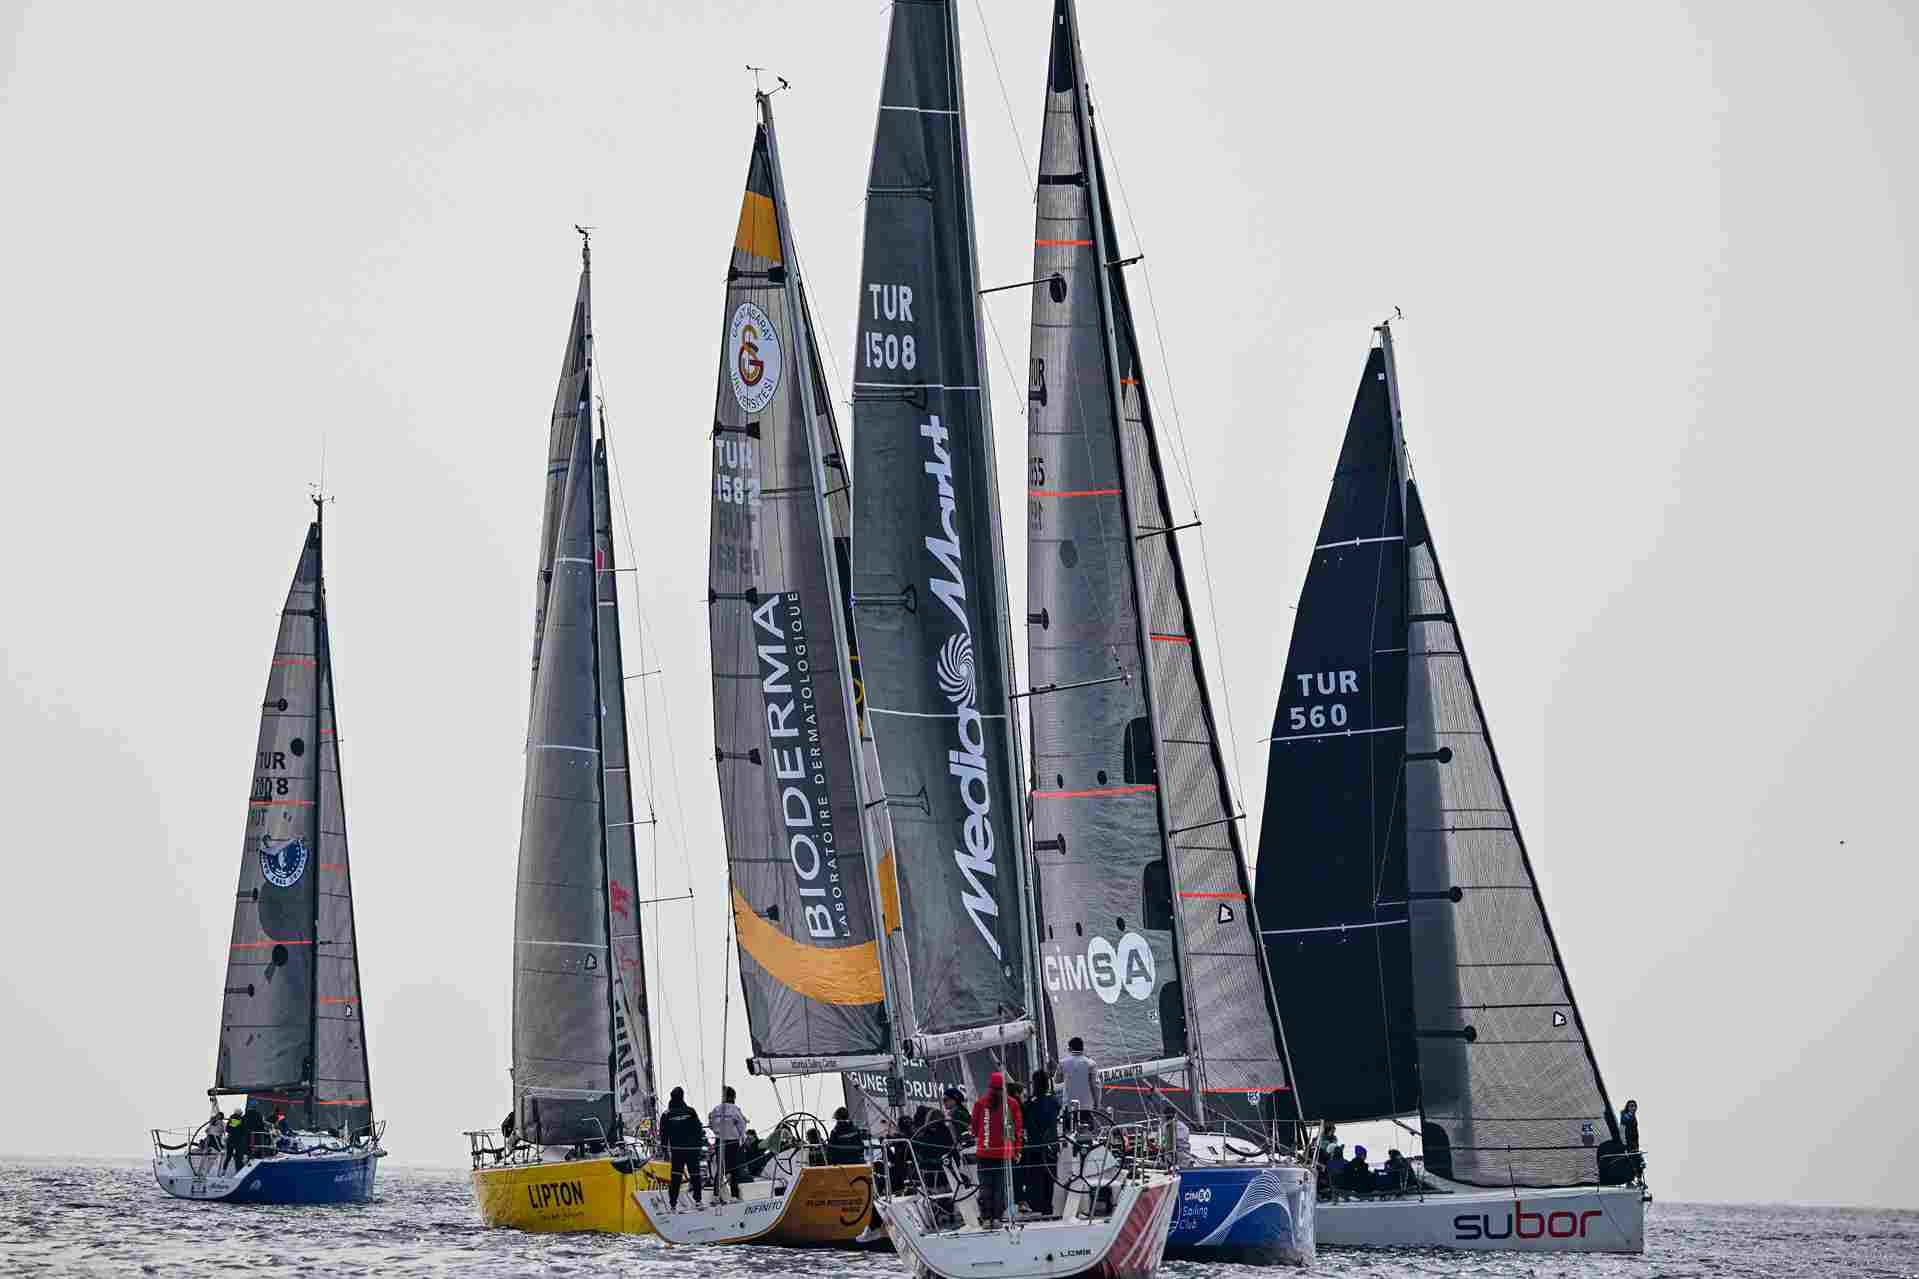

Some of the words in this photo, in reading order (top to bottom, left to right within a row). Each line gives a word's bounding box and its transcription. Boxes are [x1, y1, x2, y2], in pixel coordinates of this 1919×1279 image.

[868, 284, 913, 322] TUR
[864, 332, 916, 370] 1508
[787, 591, 825, 784] DERMATOLOGIQUE
[1296, 670, 1360, 697] TUR
[1289, 703, 1348, 730] 560
[753, 594, 836, 938] BIODERMA
[818, 796, 850, 937] LABORATOIRE
[528, 1181, 585, 1209] LIPTON
[1183, 1205, 1208, 1217] Sailing
[1453, 1200, 1602, 1241] subor
